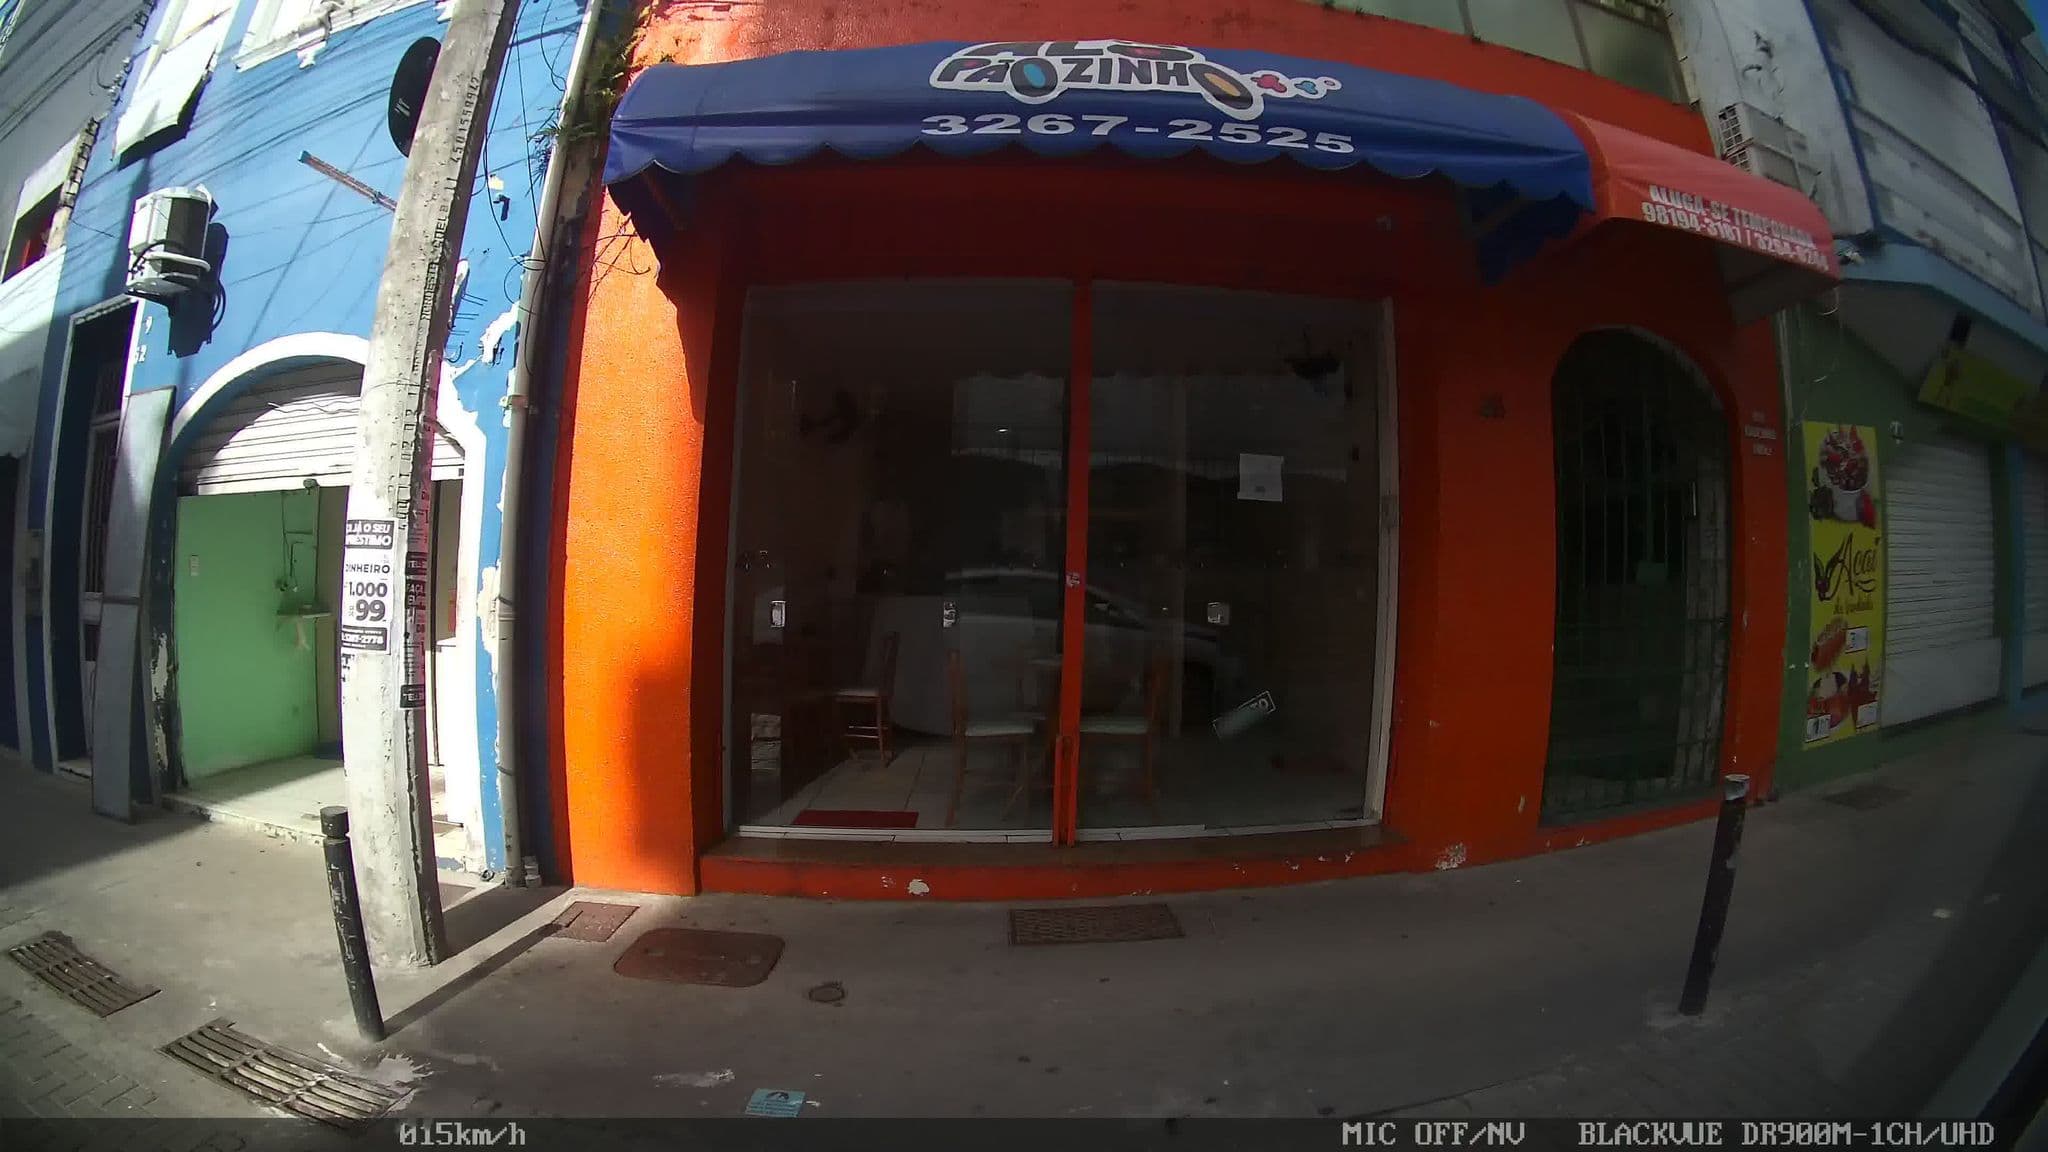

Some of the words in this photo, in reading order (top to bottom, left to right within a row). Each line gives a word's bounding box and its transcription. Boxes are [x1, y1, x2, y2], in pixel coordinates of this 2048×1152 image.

[920, 113, 1355, 154] 3267-2525
[349, 581, 388, 598] 1.000
[355, 599, 386, 622] 99
